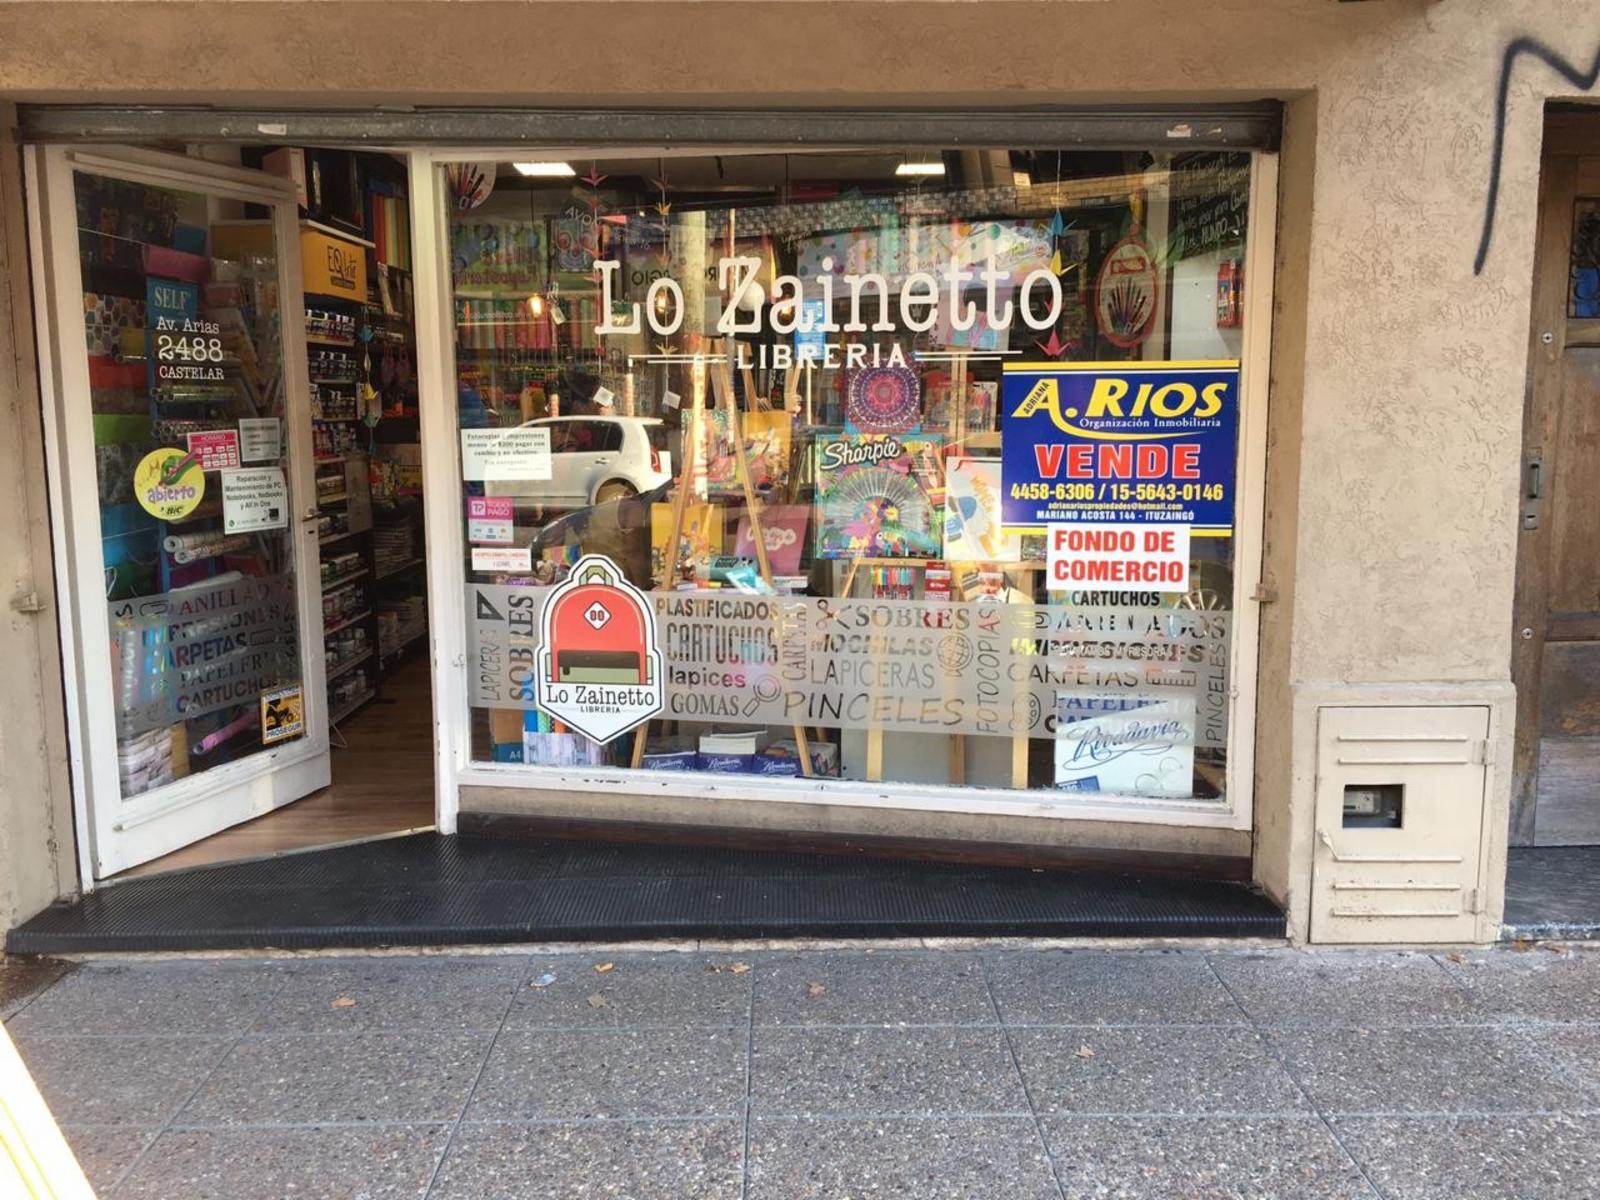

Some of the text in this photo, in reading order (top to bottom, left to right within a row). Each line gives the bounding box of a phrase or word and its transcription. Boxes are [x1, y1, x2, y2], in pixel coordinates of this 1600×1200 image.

[155, 287, 189, 309] SELF
[593, 255, 1063, 335] Lo Zainetto
[156, 316, 220, 334] Av. Arias
[158, 335, 223, 362] 2488
[737, 343, 909, 370] LIBRERIA
[160, 366, 224, 380] CASTELAR
[1023, 381, 1050, 415] ADRIANA
[1079, 417, 1221, 430] Organización Inmobiliaria
[820, 437, 900, 470] Sharpie
[1034, 443, 1201, 480] VENDE
[147, 485, 197, 504] abierto
[1010, 483, 1095, 500] 4458-6306
[1110, 483, 1224, 501] 15-5643-0146
[1036, 510, 1078, 520] MARIANO
[1080, 510, 1116, 520] ACOSTA
[1119, 510, 1136, 520] 144
[1055, 530, 1175, 553] FONDO DE
[1054, 560, 1184, 583] COMERCIO
[656, 597, 779, 621] PLASTIFICADOS
[1072, 590, 1161, 607] CARTUCHOS
[855, 604, 971, 630] SOBRES
[667, 622, 779, 665] CARTUCHOS
[669, 666, 746, 688] lapices
[811, 659, 936, 689] LAPICERAS
[976, 607, 1001, 733] FOTOCOPIAS
[545, 685, 655, 706] Lo Zainetto
[1206, 642, 1226, 742] PINCELES
[580, 706, 621, 714] LIBRERIA
[671, 692, 740, 716] GOMAS
[783, 690, 965, 726] PINCELES
[266, 722, 302, 739] PROSEGUR
